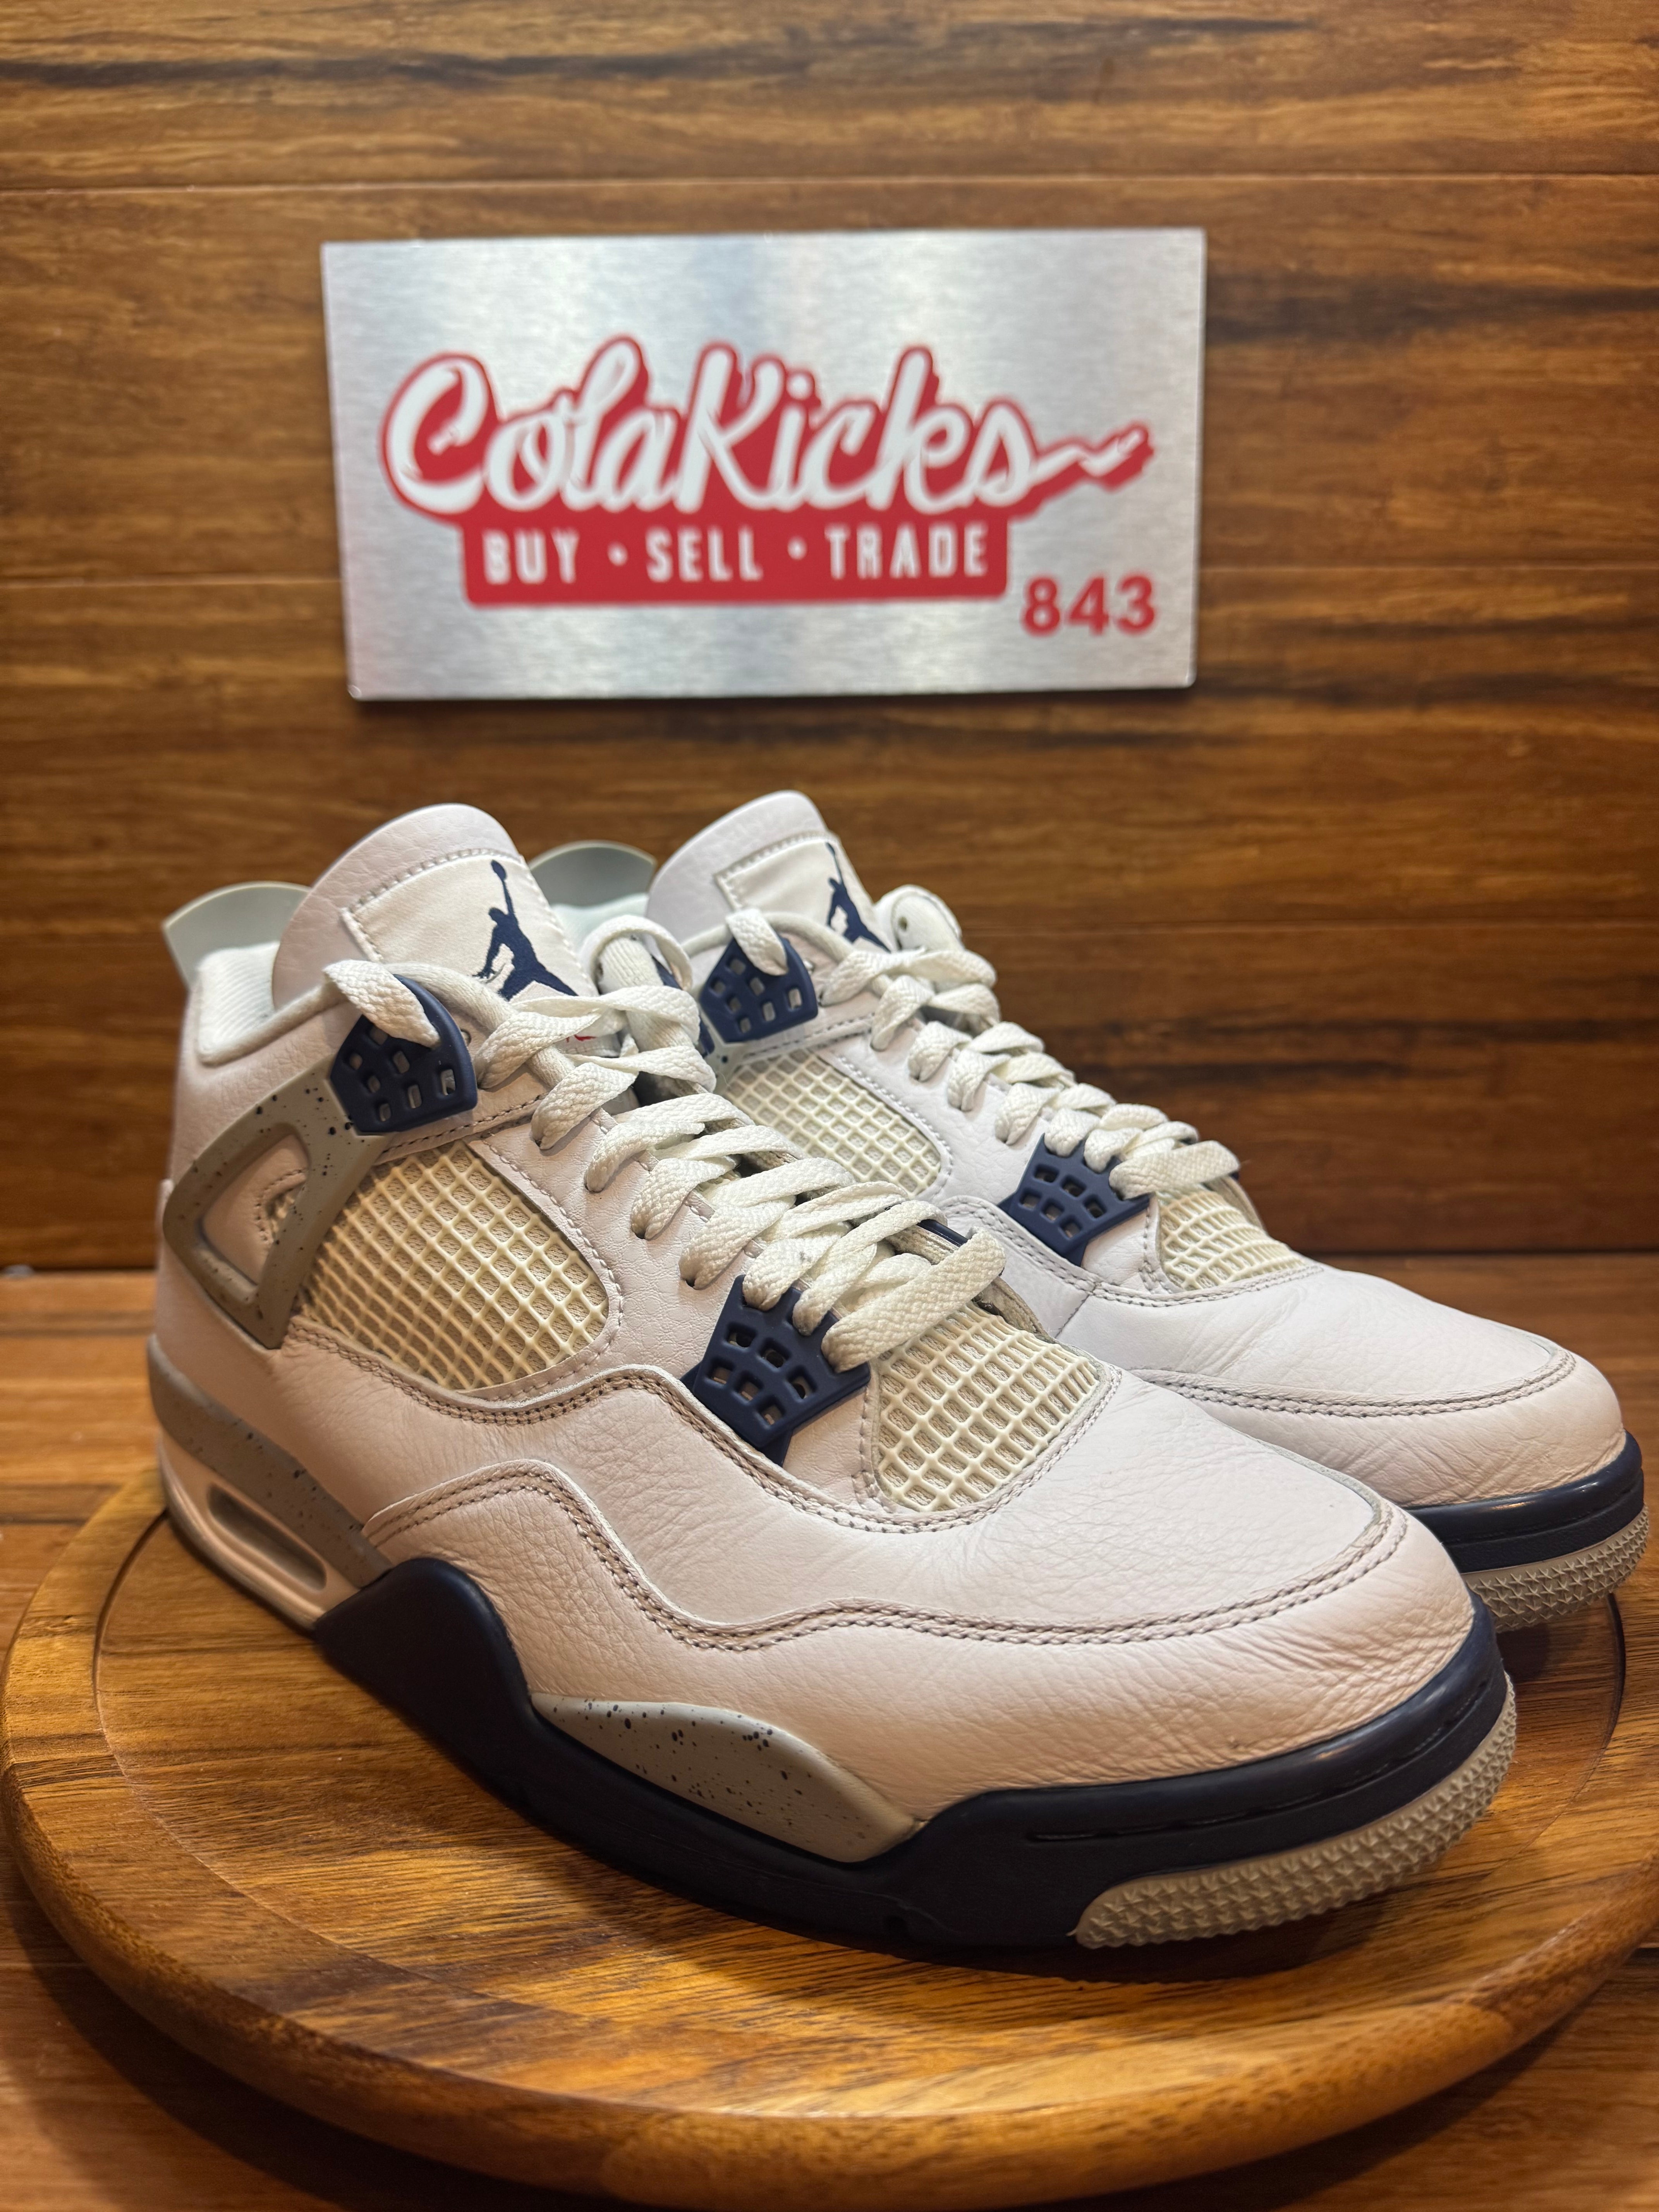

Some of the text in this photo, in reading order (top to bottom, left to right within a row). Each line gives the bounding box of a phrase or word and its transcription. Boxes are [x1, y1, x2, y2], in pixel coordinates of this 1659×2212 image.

[381, 335, 1155, 521] ColaKicks
[483, 524, 989, 584] BUY SELL TRADE
[1022, 573, 1157, 636] 843
